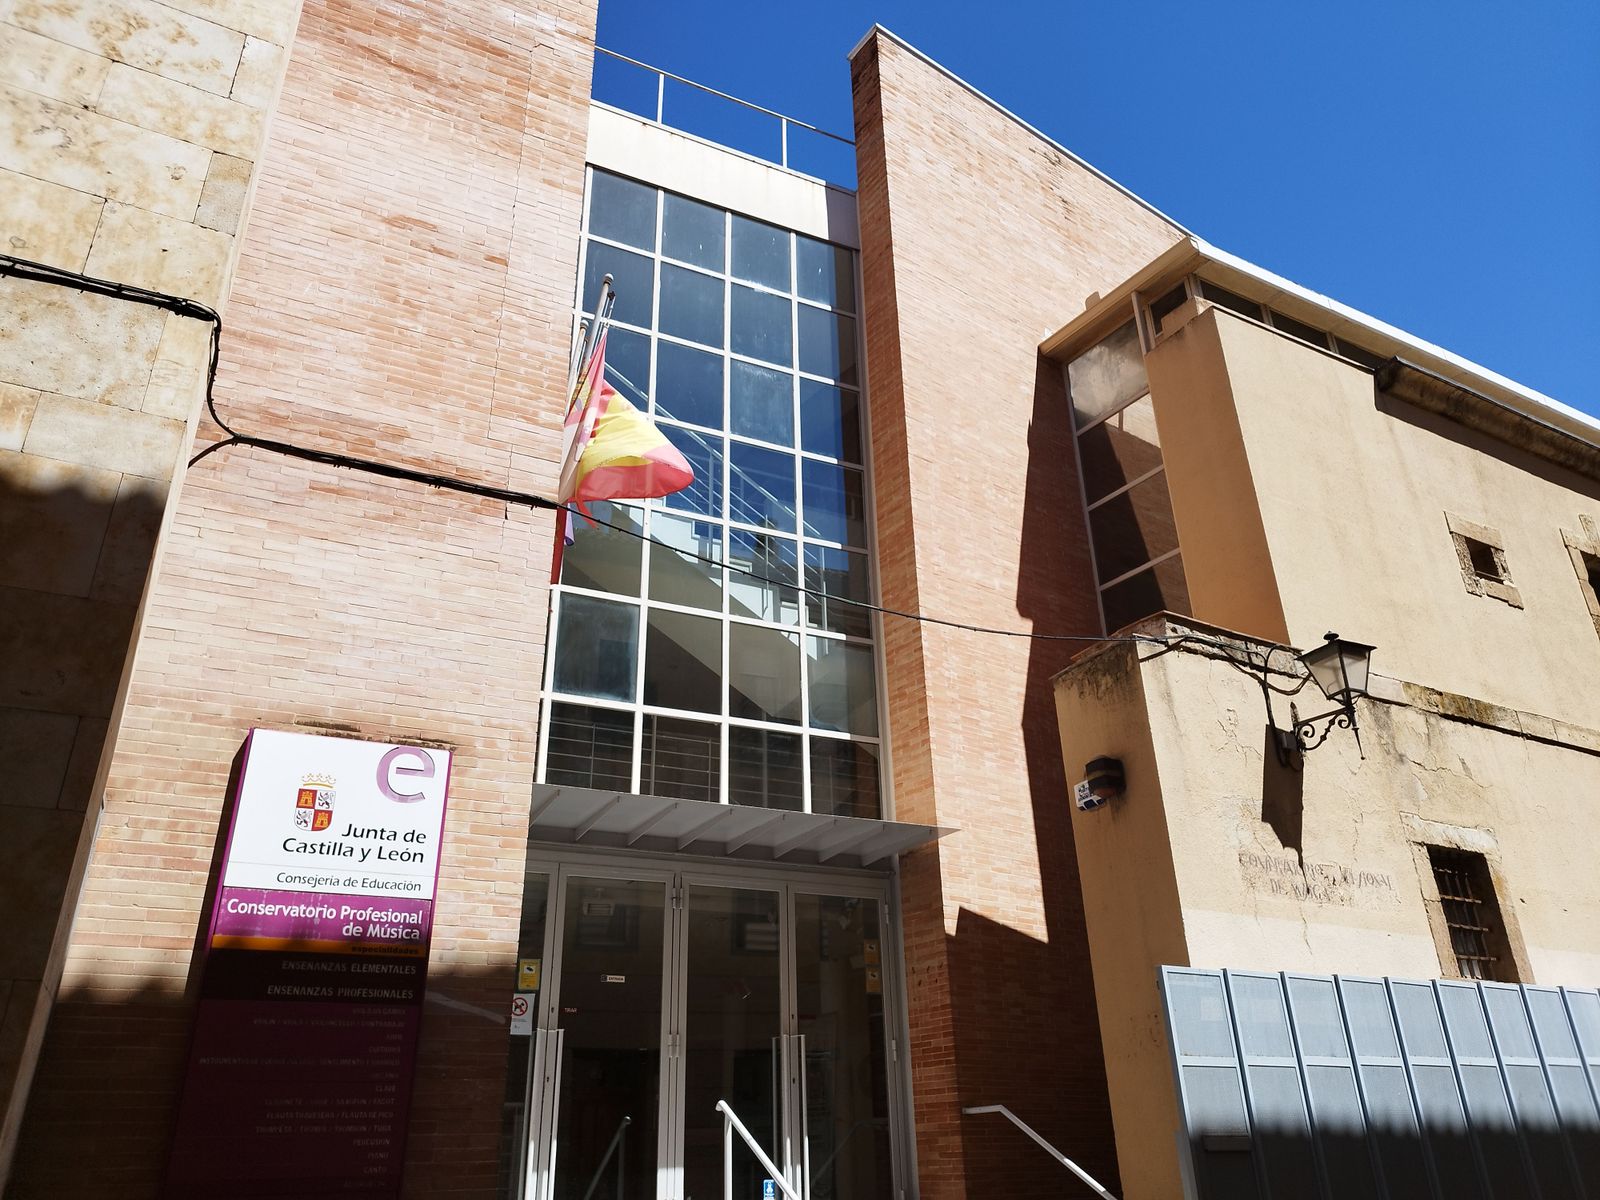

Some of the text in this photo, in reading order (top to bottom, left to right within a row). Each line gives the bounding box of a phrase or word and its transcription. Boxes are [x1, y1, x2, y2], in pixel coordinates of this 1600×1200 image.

[342, 824, 427, 844] Junta de
[282, 838, 424, 863] Castilla y León
[343, 877, 358, 887] de
[361, 878, 421, 891] Educación
[227, 899, 423, 924] Conservatorio Profesional
[342, 923, 420, 940] de Música
[351, 946, 419, 956] especialidades
[351, 963, 417, 975] ELEMENTALES
[338, 988, 415, 1000] PROFESIONALES
